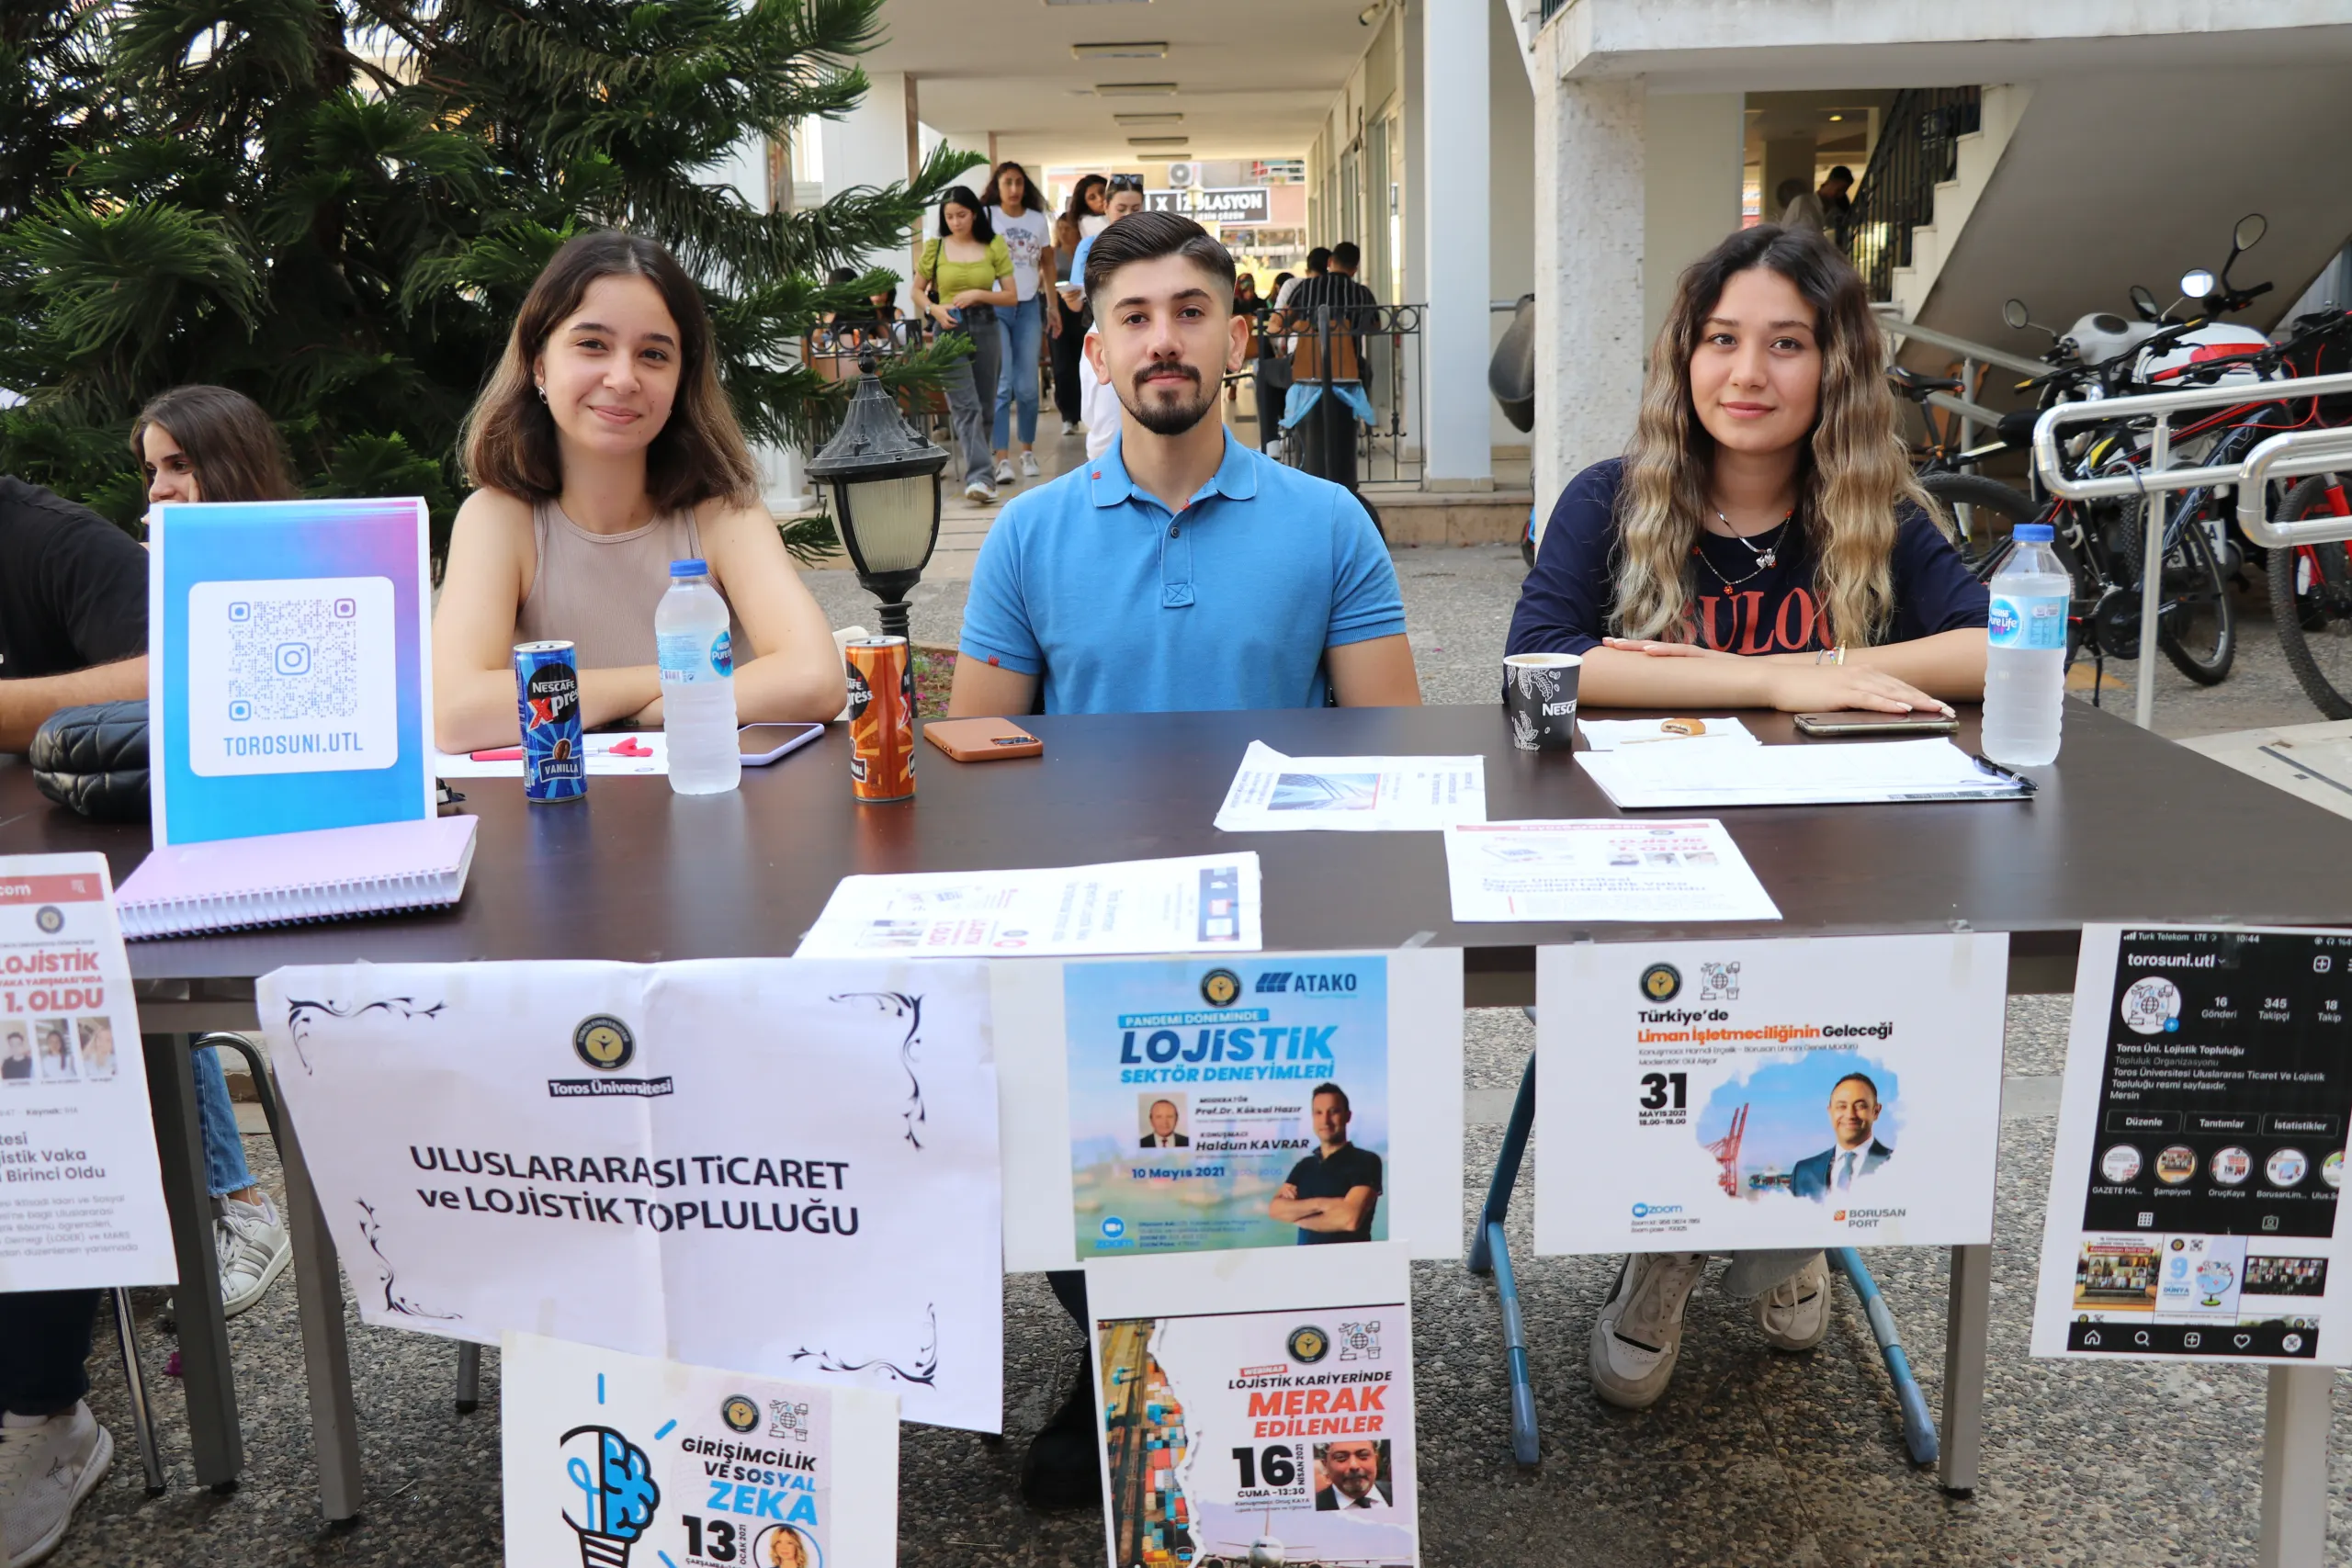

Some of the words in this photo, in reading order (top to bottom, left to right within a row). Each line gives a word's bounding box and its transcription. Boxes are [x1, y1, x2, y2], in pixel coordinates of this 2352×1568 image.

[223, 732, 364, 757] TOROSUNI.UTL
[545, 763, 578, 775] VANILLA
[0, 948, 99, 975] OJİSTİK
[2127, 953, 2215, 967] torosuni.utl
[1294, 974, 1357, 992] ATAKO
[4, 991, 24, 1012] 1.
[28, 987, 104, 1011] OLDU
[2214, 996, 2227, 1007] 16
[2264, 998, 2287, 1009] 345
[2325, 999, 2338, 1010] 18
[2318, 1011, 2341, 1022] Takip
[1637, 1029, 1690, 1043] Liman
[1822, 1022, 1894, 1040] Geleceği
[2117, 1043, 2142, 1053] Toros
[2164, 1044, 2197, 1055] Lojistik
[2199, 1044, 2245, 1055] Topluluğu
[1120, 1064, 1199, 1083] SEKTÖR
[1203, 1060, 1335, 1081] DENEYİMLERİ
[2113, 1067, 2138, 1077] Toros
[550, 1082, 590, 1095] Toros
[591, 1078, 672, 1095] Üniversitesi
[1640, 1072, 1687, 1110] 31
[2155, 1080, 2181, 1089] resmi
[2109, 1090, 2140, 1100] Mersin
[2125, 1117, 2163, 1126] Düzenle
[1195, 1140, 1247, 1151] Haldun
[1250, 1139, 1309, 1150] KAVRAR
[41, 1147, 86, 1162] Vaka
[7, 1167, 60, 1182] Birinci
[65, 1166, 106, 1179] Oldu
[410, 1145, 685, 1189] ULUSLARARASI
[1132, 1168, 1146, 1179] 10
[1149, 1168, 1193, 1180] Mayıs
[1195, 1167, 1225, 1177] 2021
[416, 1188, 460, 1209] ve
[465, 1186, 623, 1224] LOJİSTİK
[625, 1198, 859, 1236] TOPLULUĞU
[1849, 1208, 1906, 1218] BORUSAN
[1849, 1219, 1879, 1228] PORT
[1228, 1374, 1292, 1389] LOJİSTİK
[1295, 1371, 1393, 1386] KARİYERİNDE
[1248, 1385, 1388, 1417] MERAK
[1253, 1415, 1385, 1438] EDİLENLER
[682, 1436, 817, 1472] GİRİŞİMCİLİK
[1295, 1444, 1304, 1460] 2021
[1232, 1445, 1295, 1488] 16
[705, 1461, 729, 1478] VE
[733, 1466, 816, 1492] SOSYAL
[1238, 1489, 1270, 1497] CUMA
[707, 1480, 818, 1526] ZEKA
[682, 1515, 736, 1562] 13
